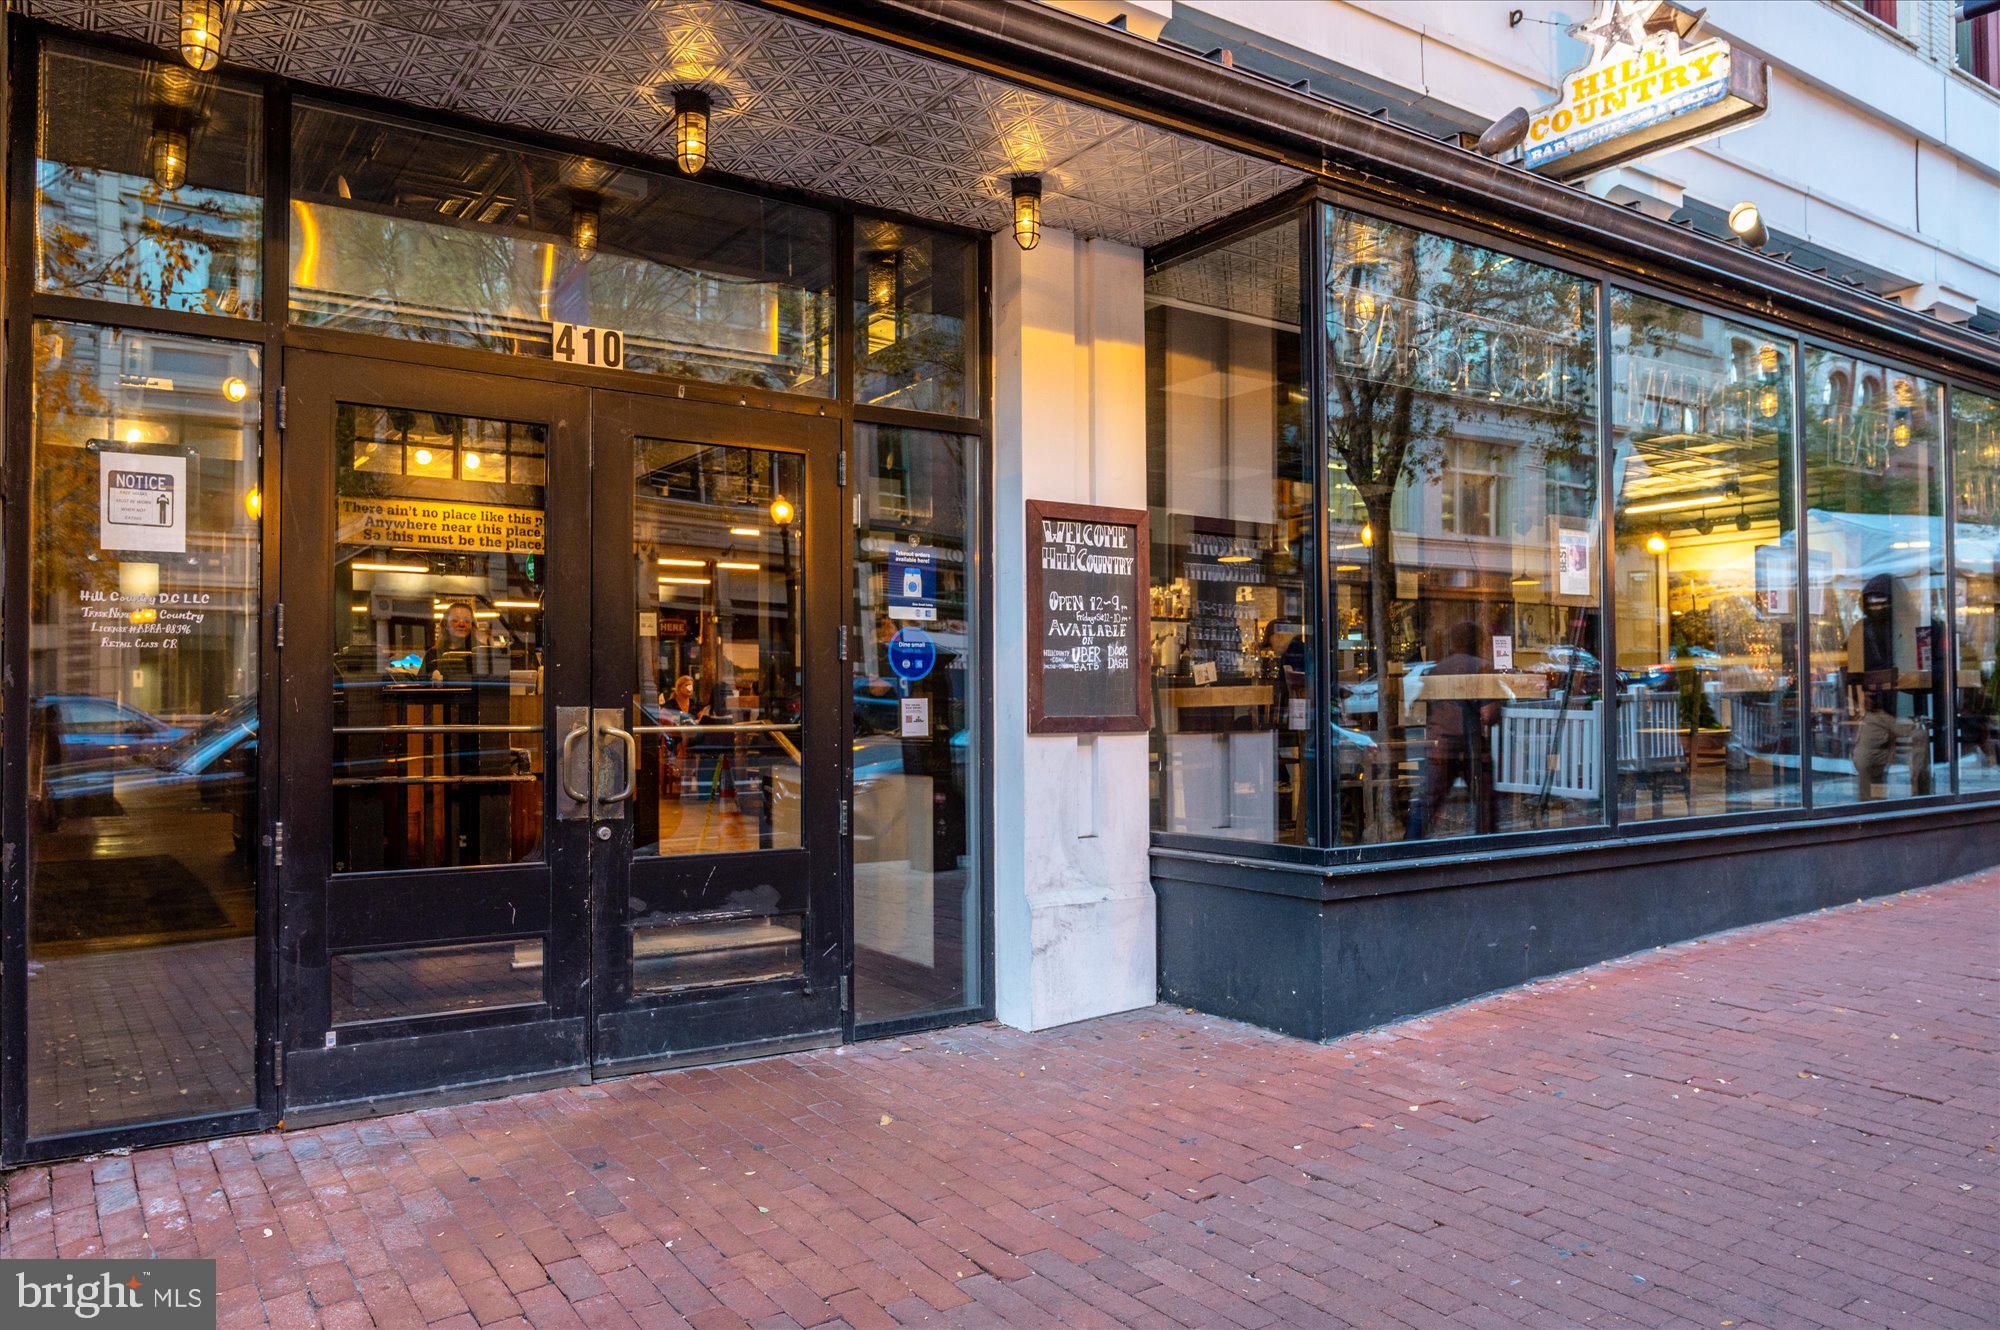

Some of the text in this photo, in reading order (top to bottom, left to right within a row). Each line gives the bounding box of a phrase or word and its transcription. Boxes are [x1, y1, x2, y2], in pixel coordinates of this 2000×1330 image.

[1572, 49, 1666, 102] HILL
[1530, 52, 1720, 141] COUNTRY
[556, 325, 621, 367] 410
[116, 473, 166, 491] NOTICE
[343, 501, 383, 515] There
[387, 505, 418, 517] ain't
[422, 508, 438, 518] no
[443, 509, 477, 521] place
[481, 510, 504, 522] like
[508, 513, 532, 525] this
[365, 516, 438, 531] Anywhere
[441, 523, 472, 533] near
[477, 524, 502, 535] this
[363, 528, 381, 541] So
[386, 531, 414, 543] this
[418, 533, 454, 545] must
[458, 535, 475, 546] be
[480, 536, 502, 548] the
[1041, 520, 1128, 549] WELCOME
[1065, 544, 1077, 554] TO
[80, 589, 107, 602] Hill
[183, 593, 210, 604] LLC
[1049, 591, 1084, 611] OPEN
[160, 609, 205, 624] Country
[660, 623, 685, 632] HERE
[1048, 619, 1127, 637] AVAILABLE
[162, 639, 178, 649] CR
[1082, 637, 1094, 646] ON
[1071, 646, 1101, 662] UBER
[1107, 645, 1128, 657] DOOR
[1074, 661, 1099, 672] EATS
[1107, 657, 1128, 669] DASH
